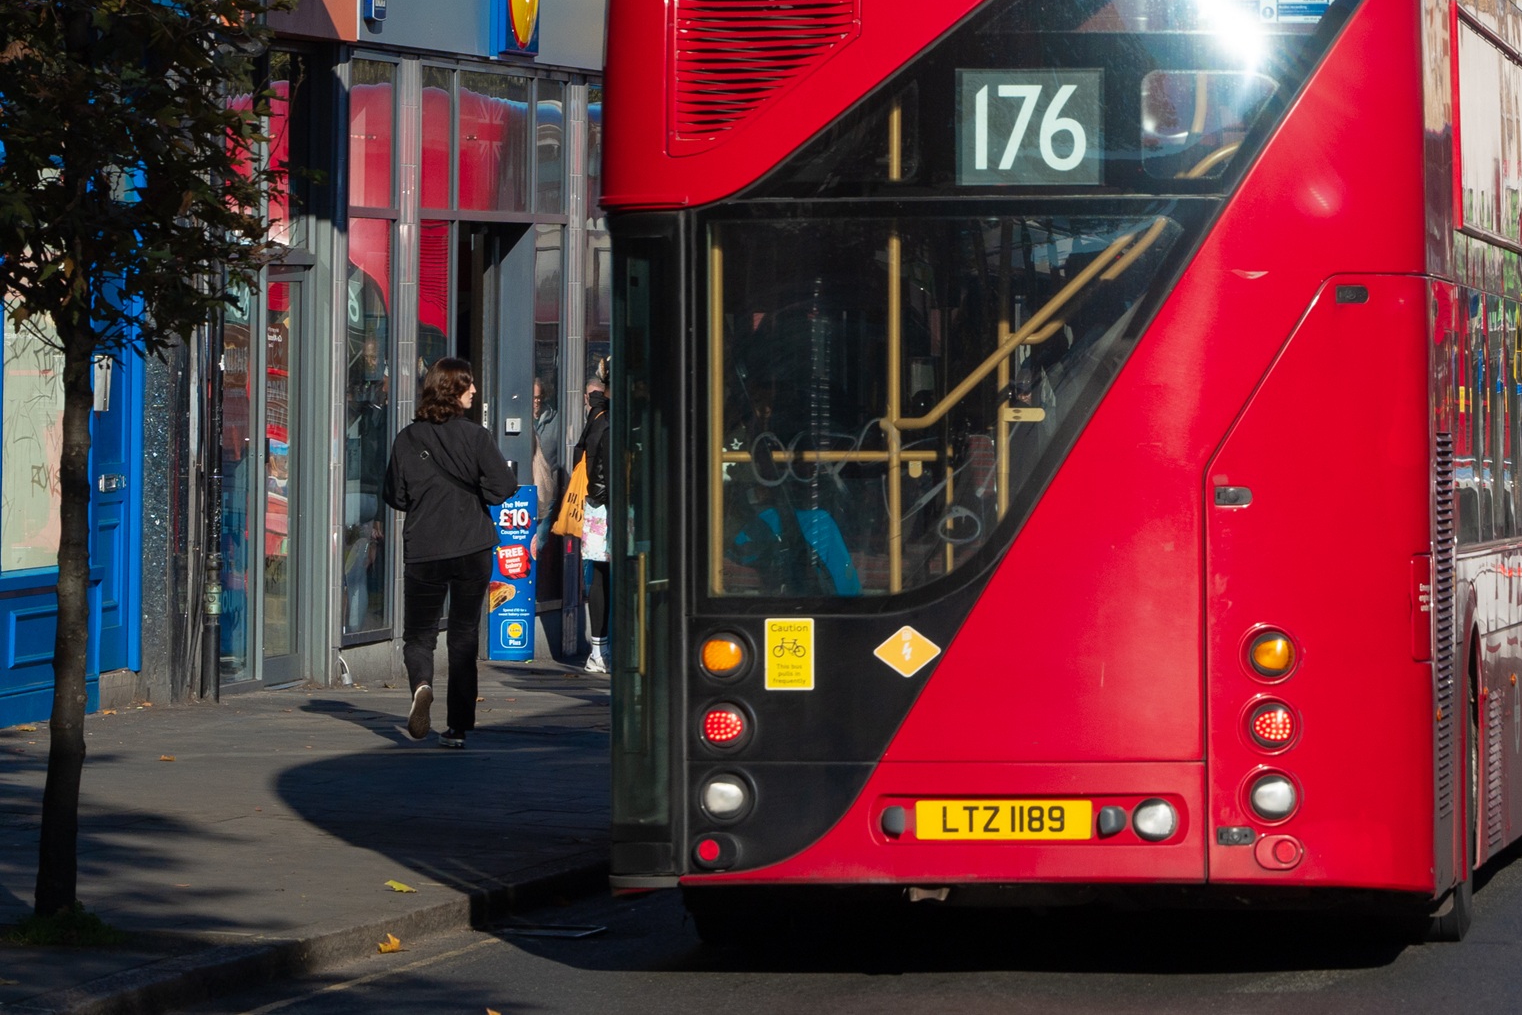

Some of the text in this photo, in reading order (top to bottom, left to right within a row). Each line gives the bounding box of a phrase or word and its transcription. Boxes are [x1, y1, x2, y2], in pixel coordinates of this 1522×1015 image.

[975, 84, 1087, 171] 176
[502, 501, 513, 509] The
[499, 508, 529, 527] £10
[500, 546, 524, 559] FREE
[771, 623, 808, 633] Caution
[942, 806, 1065, 833] LTZ 1189
